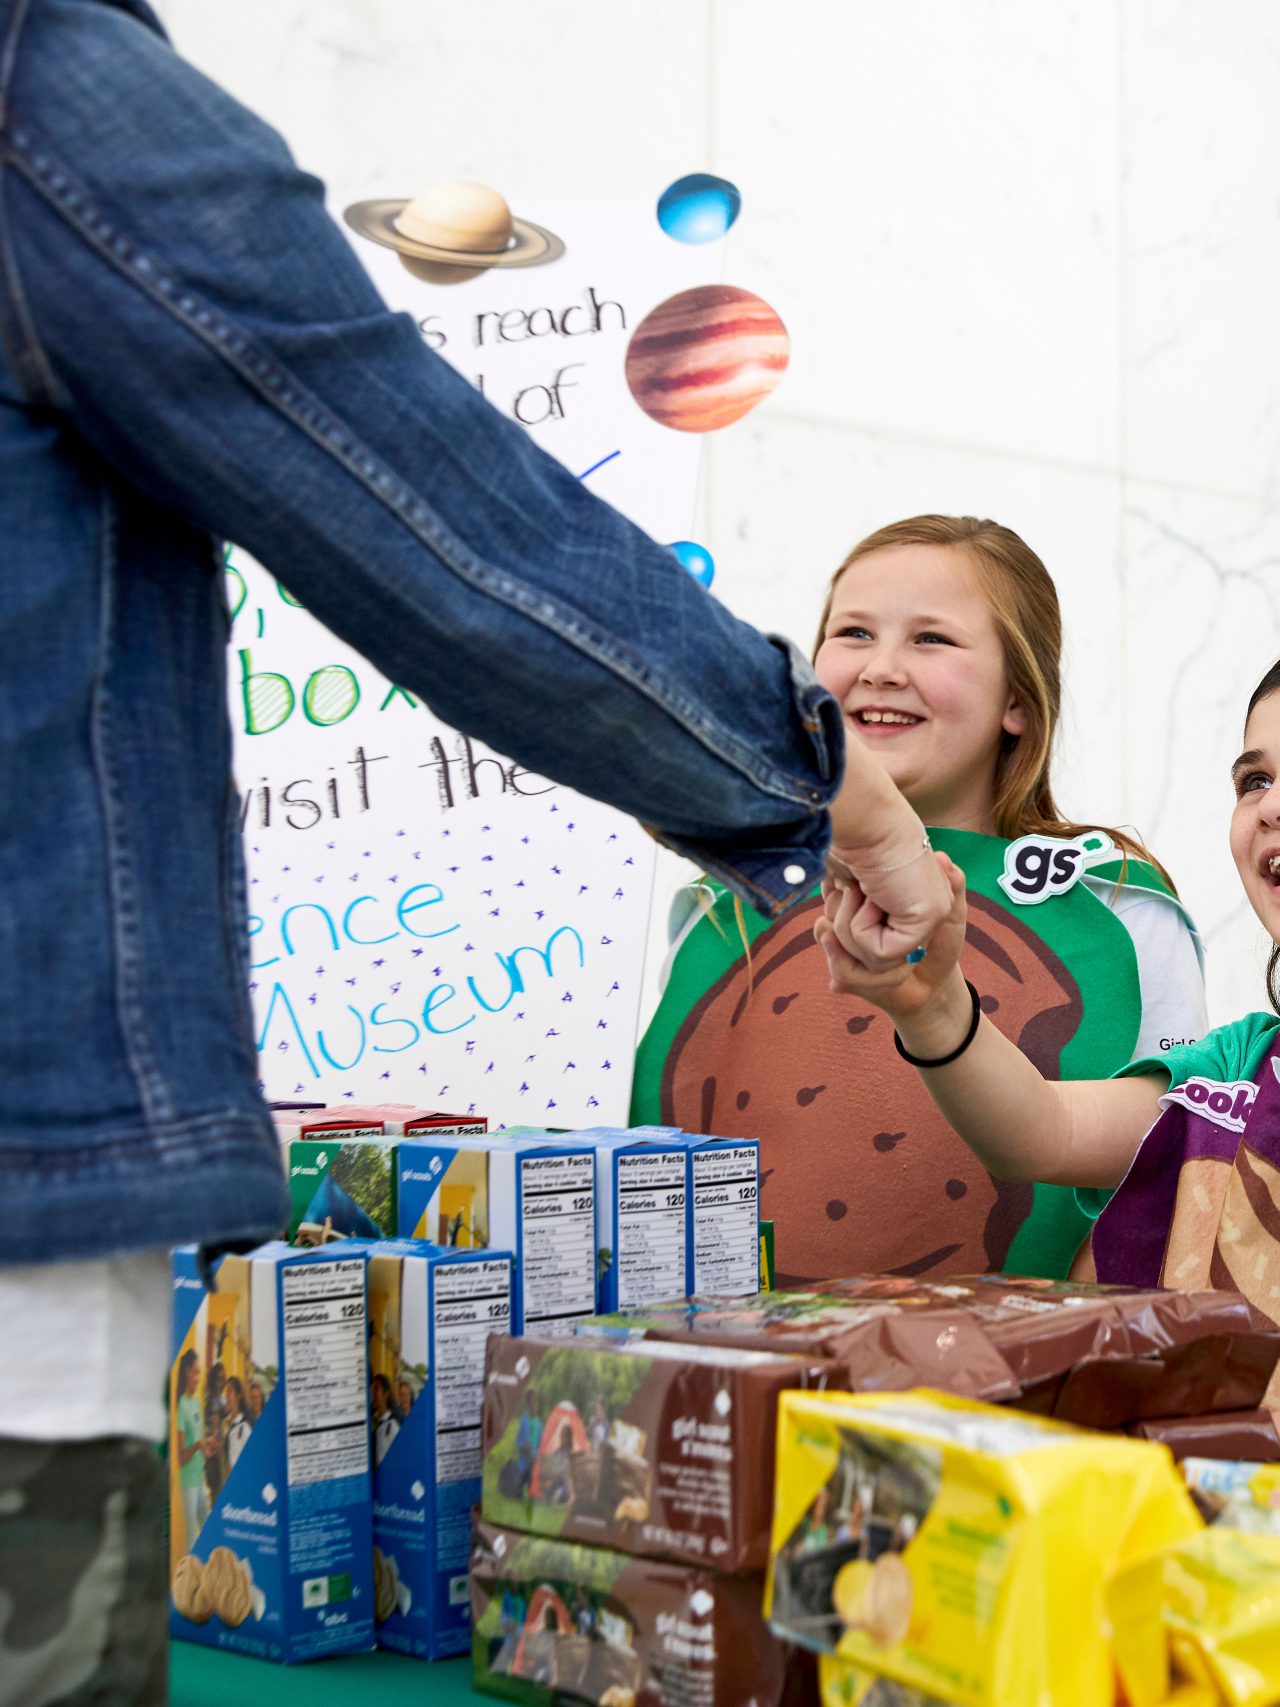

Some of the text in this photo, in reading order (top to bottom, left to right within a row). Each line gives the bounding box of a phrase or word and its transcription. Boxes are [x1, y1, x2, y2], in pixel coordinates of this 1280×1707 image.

[476, 287, 626, 346] reach
[514, 363, 586, 425] of
[418, 733, 557, 810] the
[1010, 845, 1082, 895] gs
[523, 1157, 592, 1170] Nutrition Facts
[619, 1155, 685, 1167] Nutrition Facts
[694, 1149, 756, 1162] Nutrition Facts
[620, 1199, 656, 1210] Calories
[666, 1194, 685, 1206] 120
[695, 1194, 729, 1205] Calories
[738, 1187, 757, 1199] 120
[524, 1204, 562, 1215] Calories
[573, 1197, 593, 1210] 120
[284, 1262, 362, 1277] Nutrition Facts
[436, 1262, 508, 1276] Nutrition Facts
[286, 1312, 330, 1324] Calories
[341, 1303, 364, 1317] 120
[436, 1311, 477, 1323] Calories
[488, 1303, 510, 1317] 120
